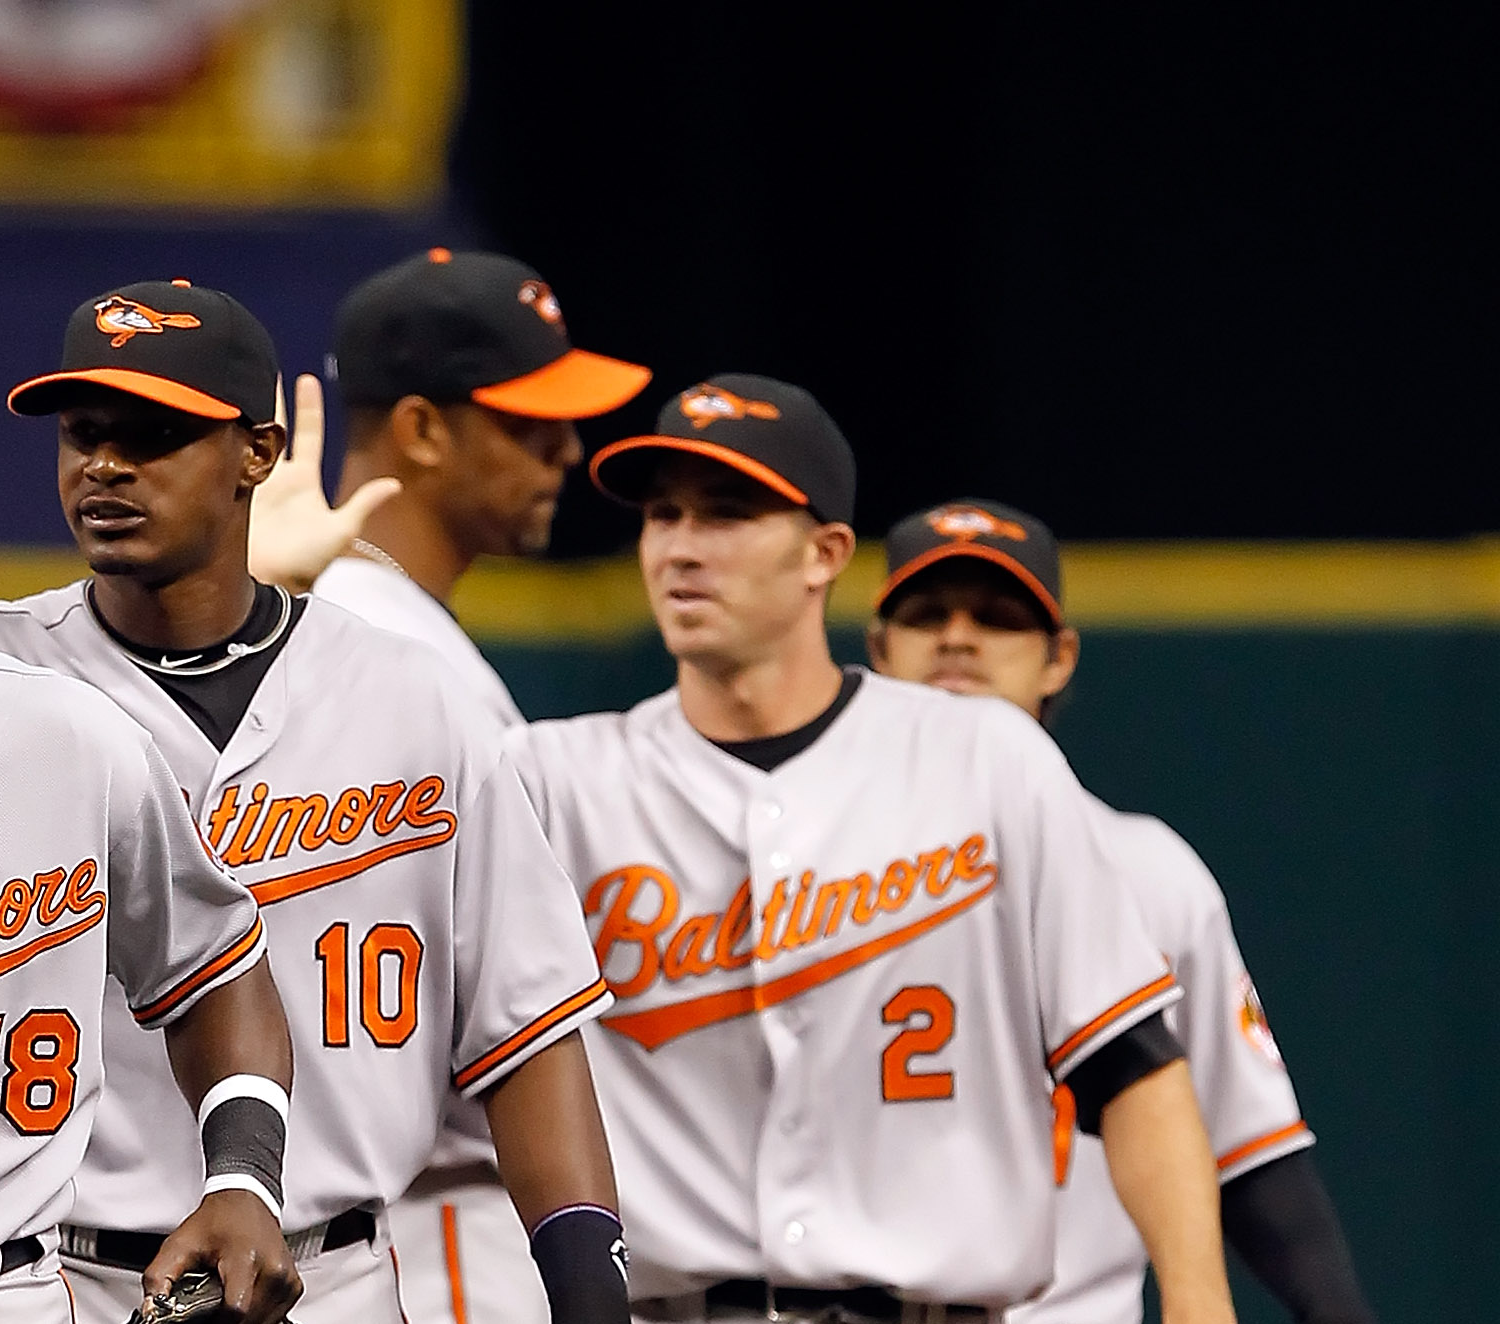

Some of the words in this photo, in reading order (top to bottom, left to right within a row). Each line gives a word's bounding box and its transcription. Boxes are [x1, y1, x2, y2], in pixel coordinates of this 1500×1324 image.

[181, 775, 457, 867] timore
[584, 833, 998, 998] Baltimore
[315, 922, 425, 1049] 10
[881, 984, 956, 1103] 2
